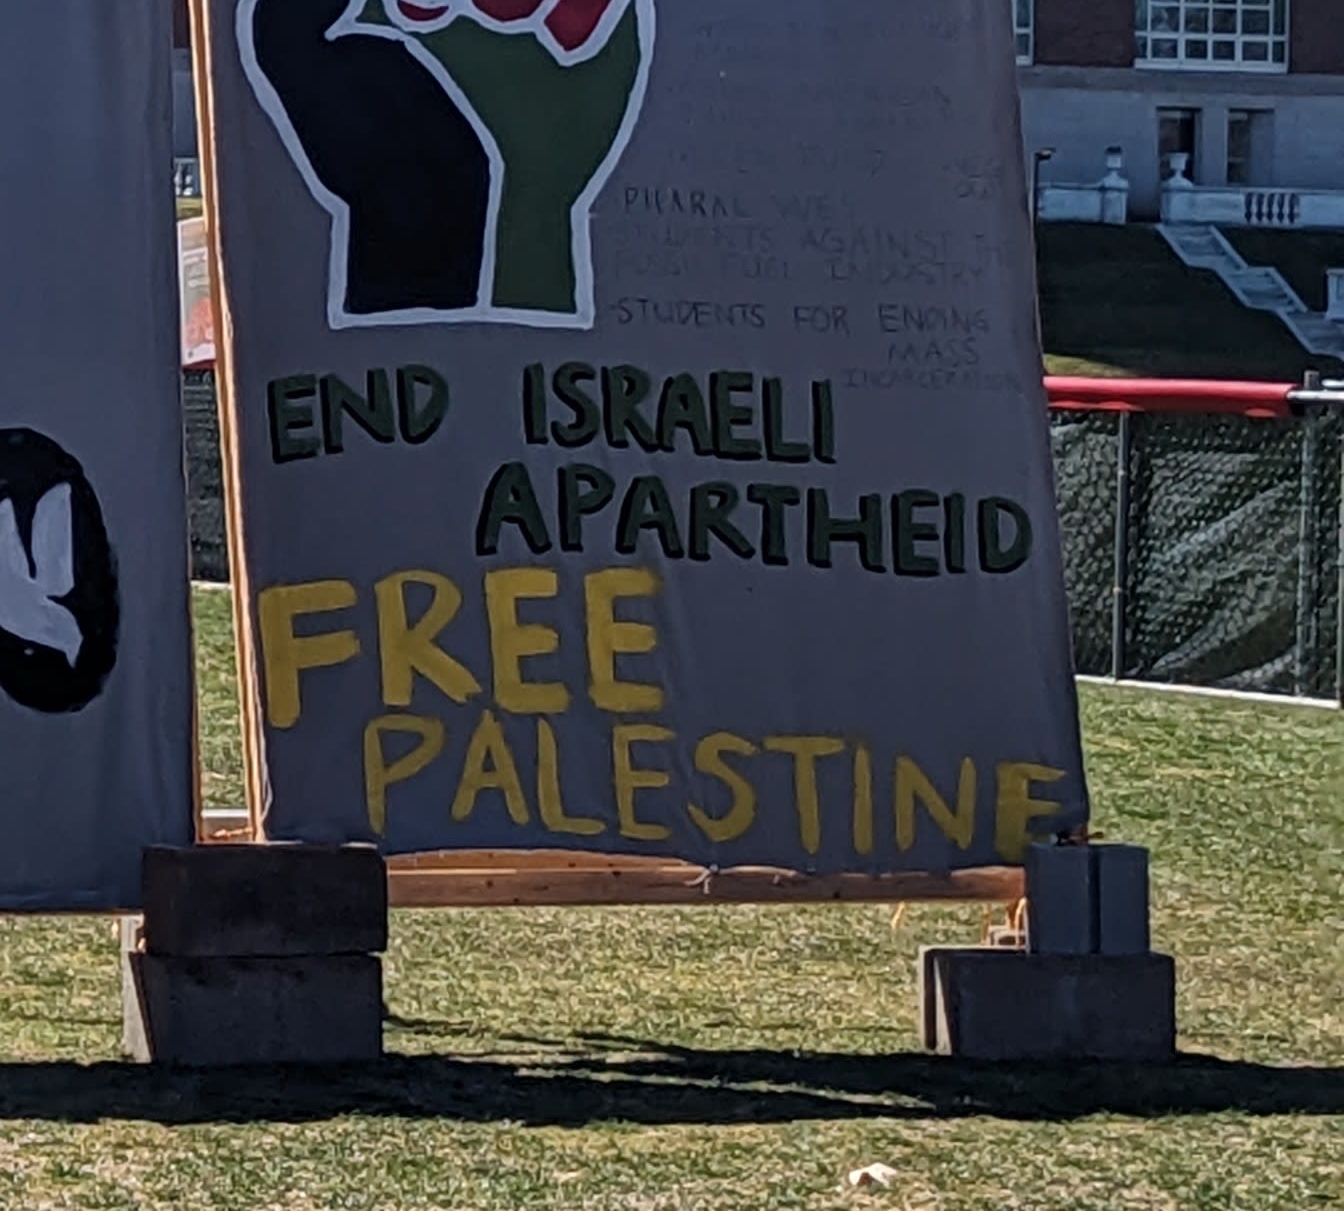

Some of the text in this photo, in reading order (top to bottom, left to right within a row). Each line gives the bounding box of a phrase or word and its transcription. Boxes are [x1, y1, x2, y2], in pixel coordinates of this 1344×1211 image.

[616, 296, 991, 337] STUDENTS FOR ENDING
[887, 337, 981, 368] MASS
[267, 360, 837, 464] END ISRAELI
[475, 461, 1032, 576] APARTHEID
[258, 566, 665, 729] FREE
[362, 708, 1069, 862] PALESTINE
